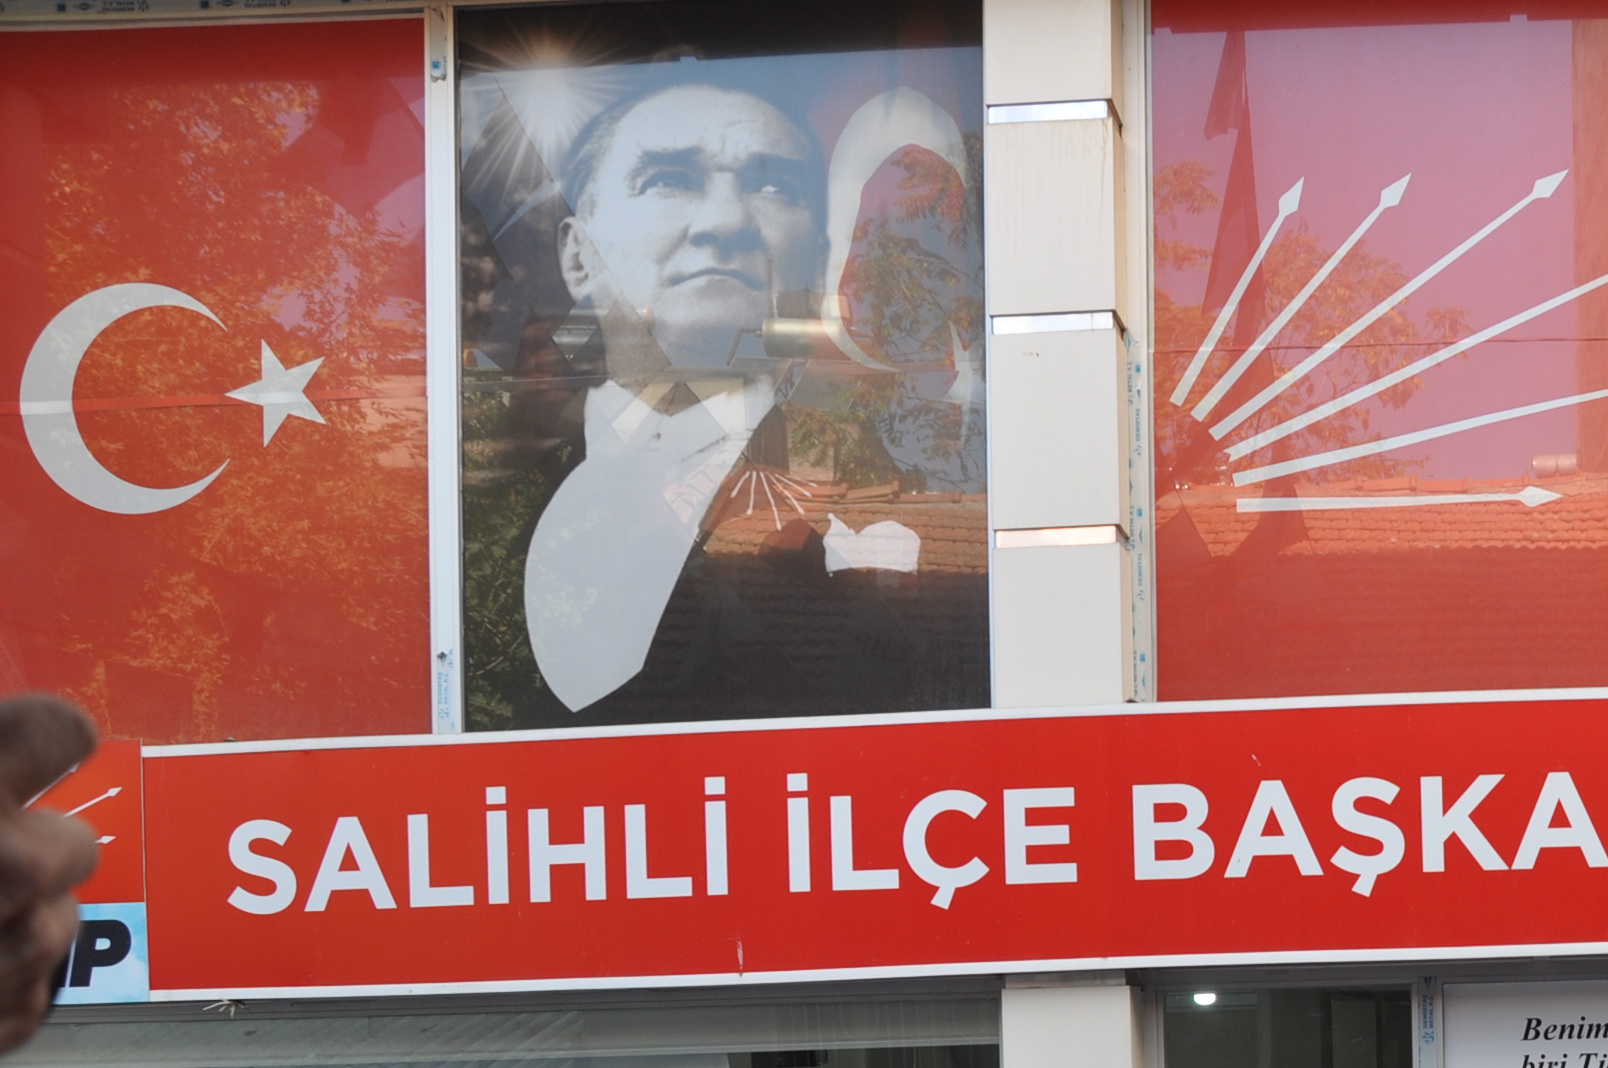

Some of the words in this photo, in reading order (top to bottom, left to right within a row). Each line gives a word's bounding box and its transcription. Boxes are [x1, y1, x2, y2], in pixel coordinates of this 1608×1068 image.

[226, 776, 729, 916] SALİHLİ
[786, 772, 1078, 910] İLÇE
[1521, 1016, 1608, 1042] Benim
